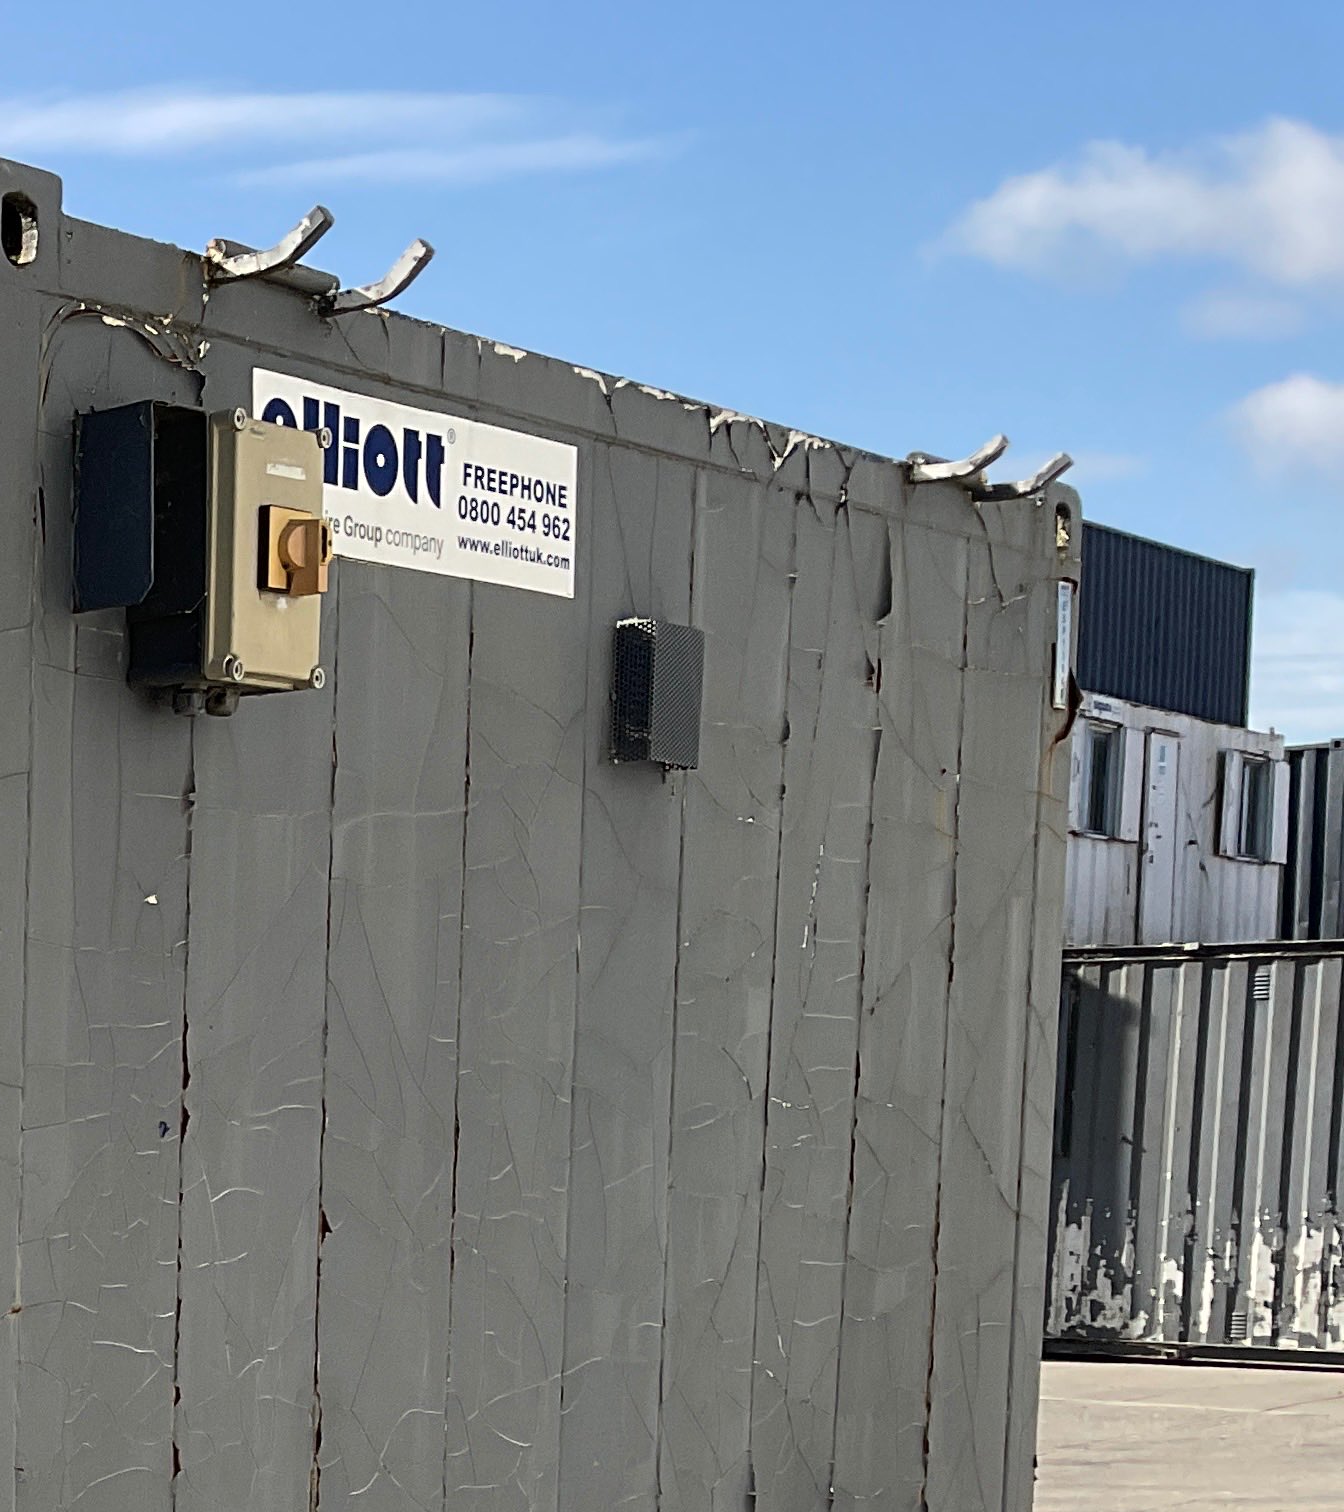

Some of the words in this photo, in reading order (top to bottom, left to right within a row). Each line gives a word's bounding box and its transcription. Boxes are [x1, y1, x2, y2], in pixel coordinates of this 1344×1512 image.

[463, 462, 568, 509] FREEPHONE
[343, 514, 383, 548] Group
[385, 528, 444, 560] company
[458, 495, 501, 526] 0800
[506, 505, 537, 534] 454
[542, 513, 571, 541] 962
[457, 535, 570, 570] www.elliottuk.com
